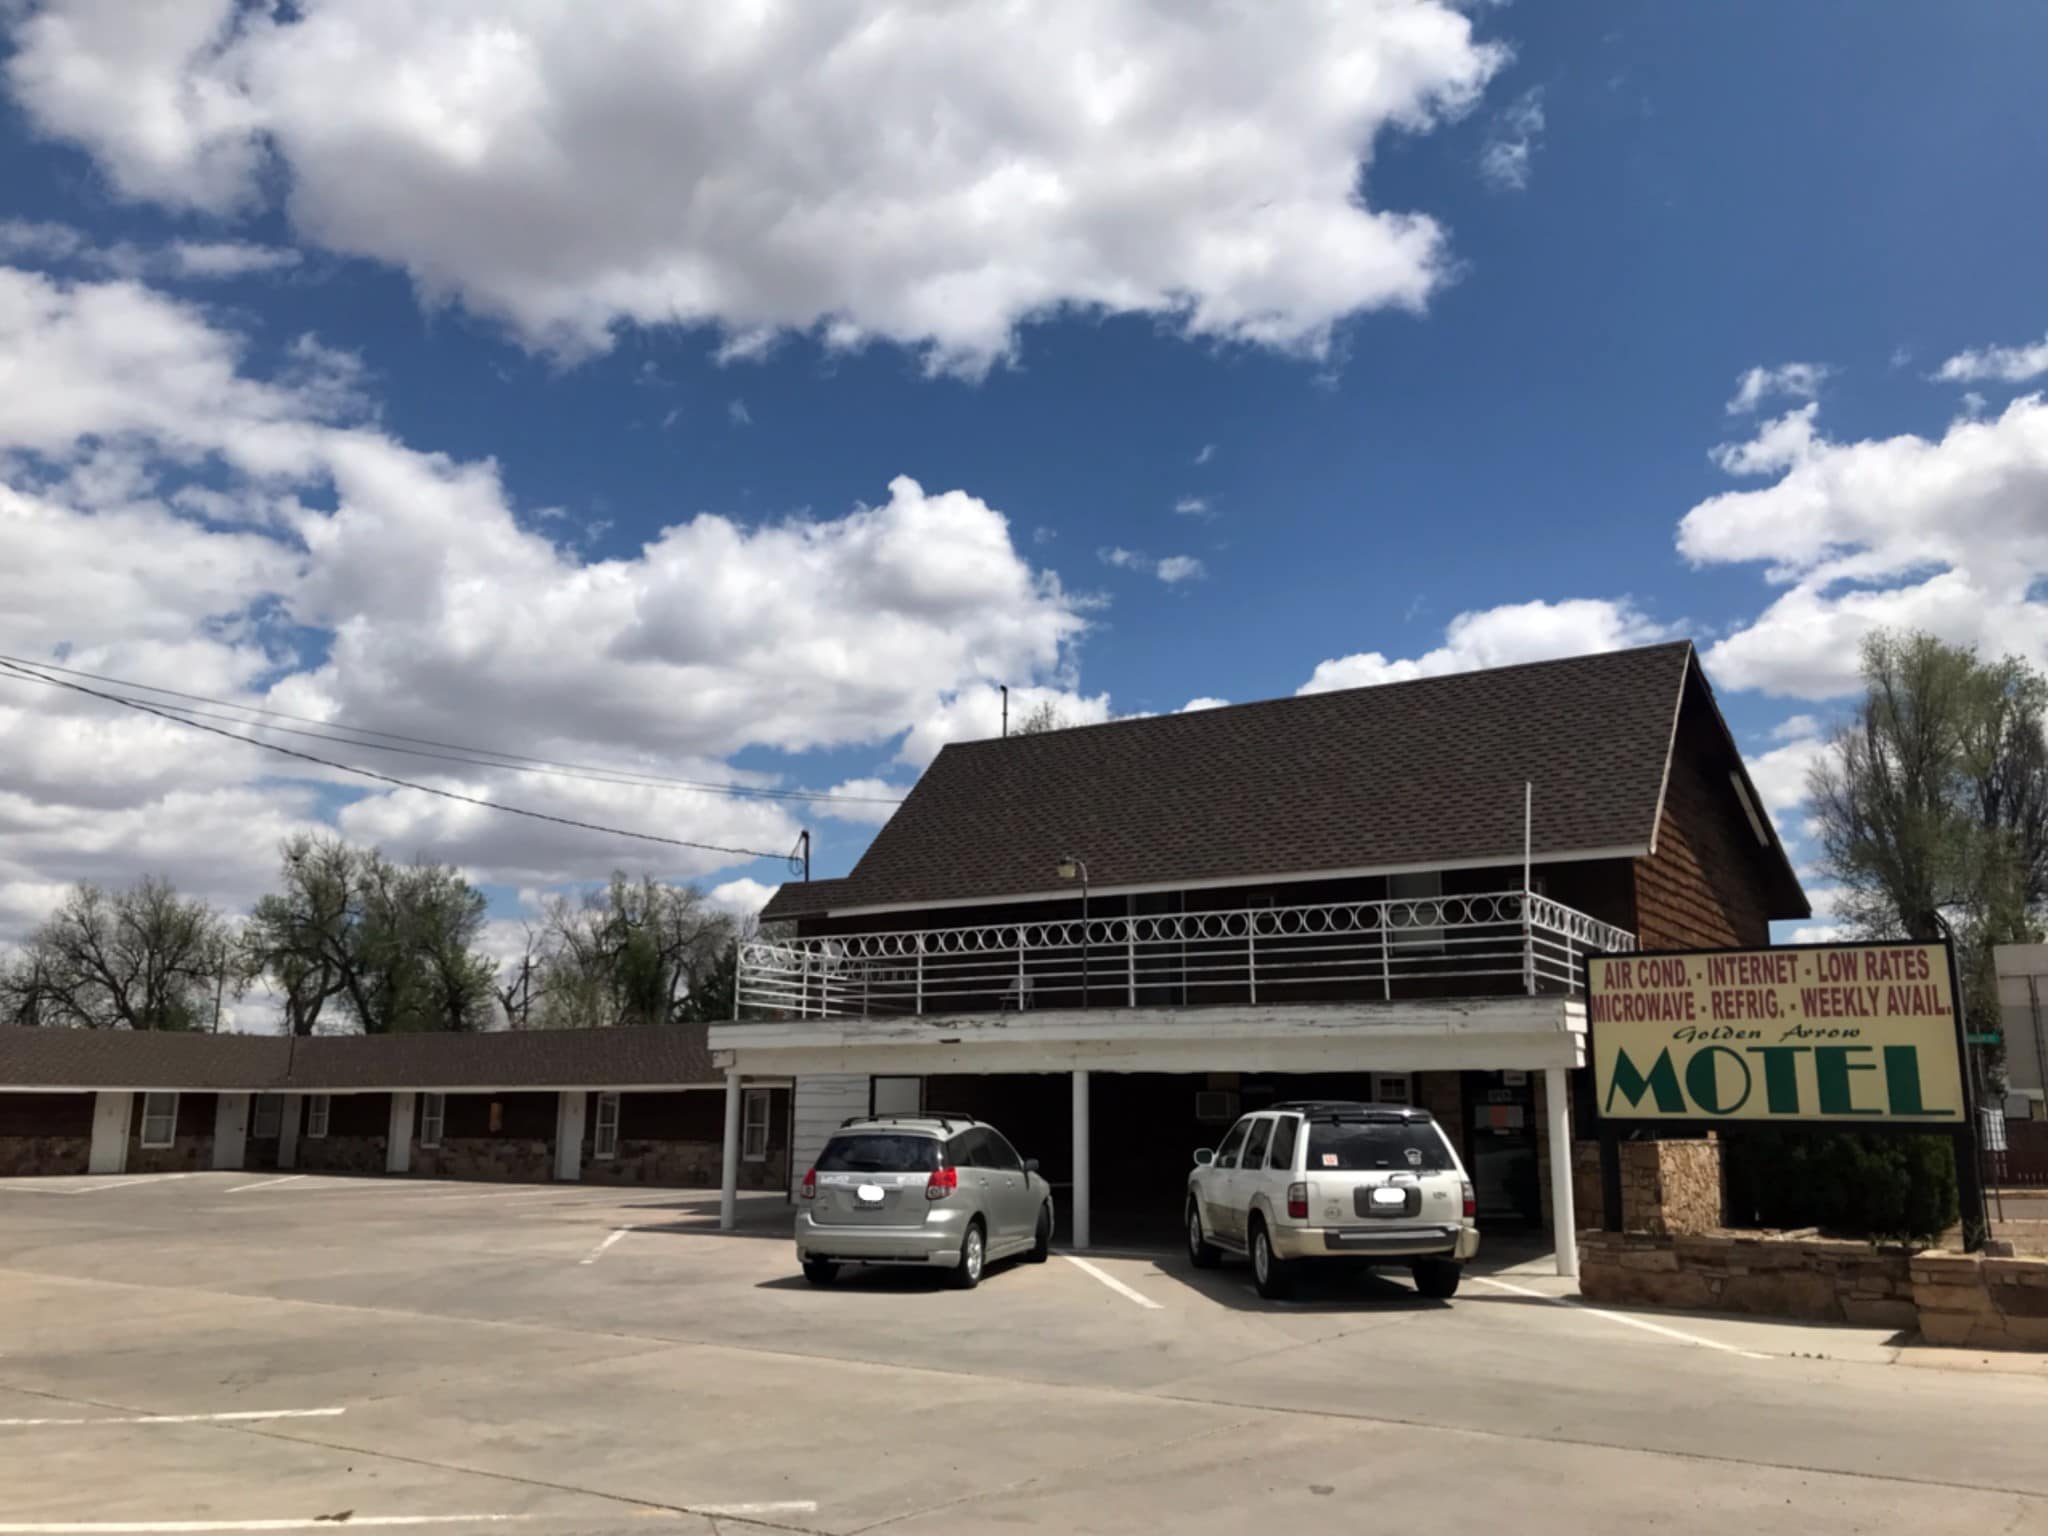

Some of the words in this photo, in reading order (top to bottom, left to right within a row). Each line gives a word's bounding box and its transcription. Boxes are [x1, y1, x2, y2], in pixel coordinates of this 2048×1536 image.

[1604, 961, 1633, 989] AIR
[1637, 958, 1691, 988] COND.
[1707, 953, 1798, 986] INTERNET
[1816, 951, 1858, 982] LOW
[1865, 949, 1930, 981] RATES
[1591, 991, 1696, 1023] MICROWAVE
[1711, 988, 1785, 1019] REFRIG.
[1801, 985, 1880, 1017] WEEKLY
[1886, 984, 1951, 1017] AVAIL.
[1672, 1025, 1761, 1043] Golden
[1778, 1024, 1860, 1043] Arrow
[1605, 1045, 1956, 1115] MOTEL
